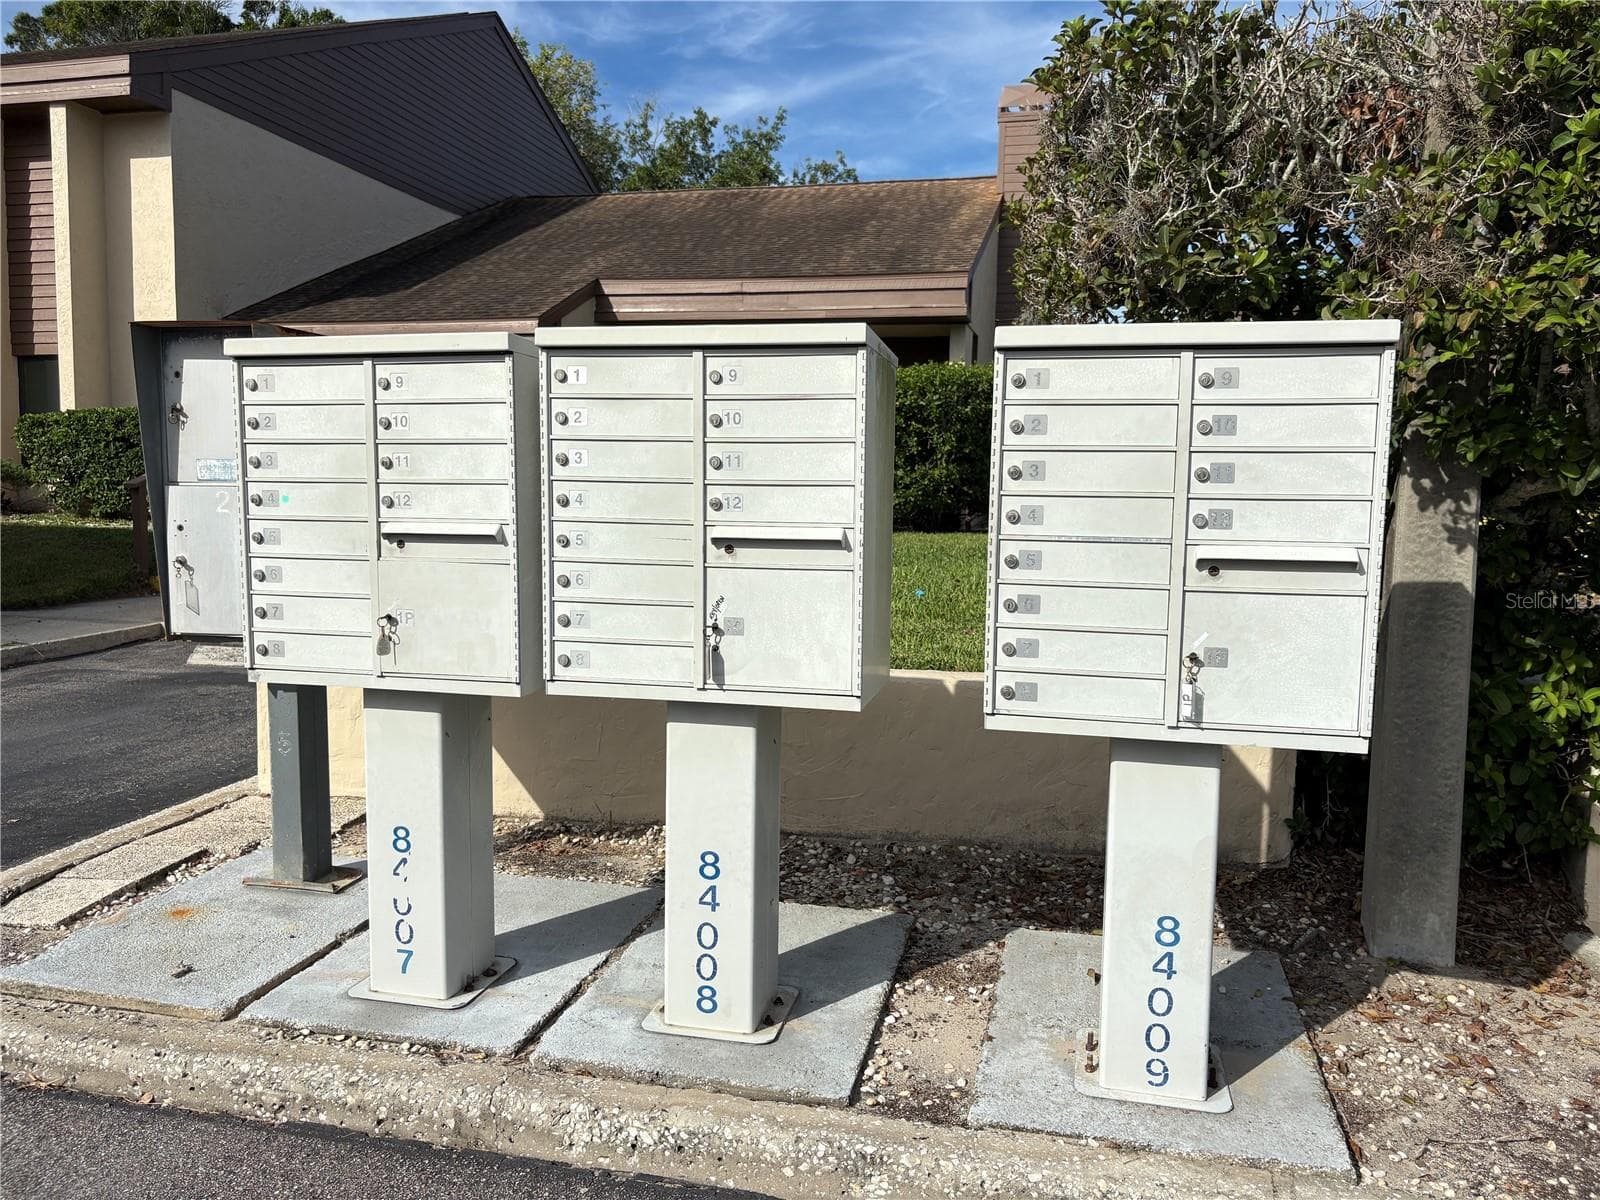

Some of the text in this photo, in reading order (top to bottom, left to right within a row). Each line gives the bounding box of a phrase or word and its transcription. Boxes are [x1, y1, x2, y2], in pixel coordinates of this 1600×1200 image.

[395, 375, 404, 388] 9
[728, 369, 737, 382] 9
[1221, 371, 1232, 386] 9
[264, 416, 271, 428] 2
[393, 416, 408, 428] 10
[574, 411, 582, 424] 2
[724, 412, 742, 425] 10
[1031, 418, 1042, 432] 2
[265, 455, 273, 467] 3
[395, 456, 409, 468] 11
[574, 452, 582, 464] 3
[725, 454, 741, 468] 11
[1029, 464, 1039, 478] 3
[215, 490, 230, 513] 2
[395, 494, 411, 507] 12
[575, 493, 584, 506] 4
[724, 496, 742, 510] 12
[1027, 508, 1037, 522] 4
[576, 533, 584, 546] 5
[1026, 553, 1036, 567] 5
[576, 573, 584, 586] 6
[272, 606, 279, 617] 7
[576, 613, 585, 626] 7
[273, 643, 280, 655] 8
[576, 653, 585, 666] 8
[695, 850, 721, 1014] 84008
[1144, 915, 1181, 1087] 84009
